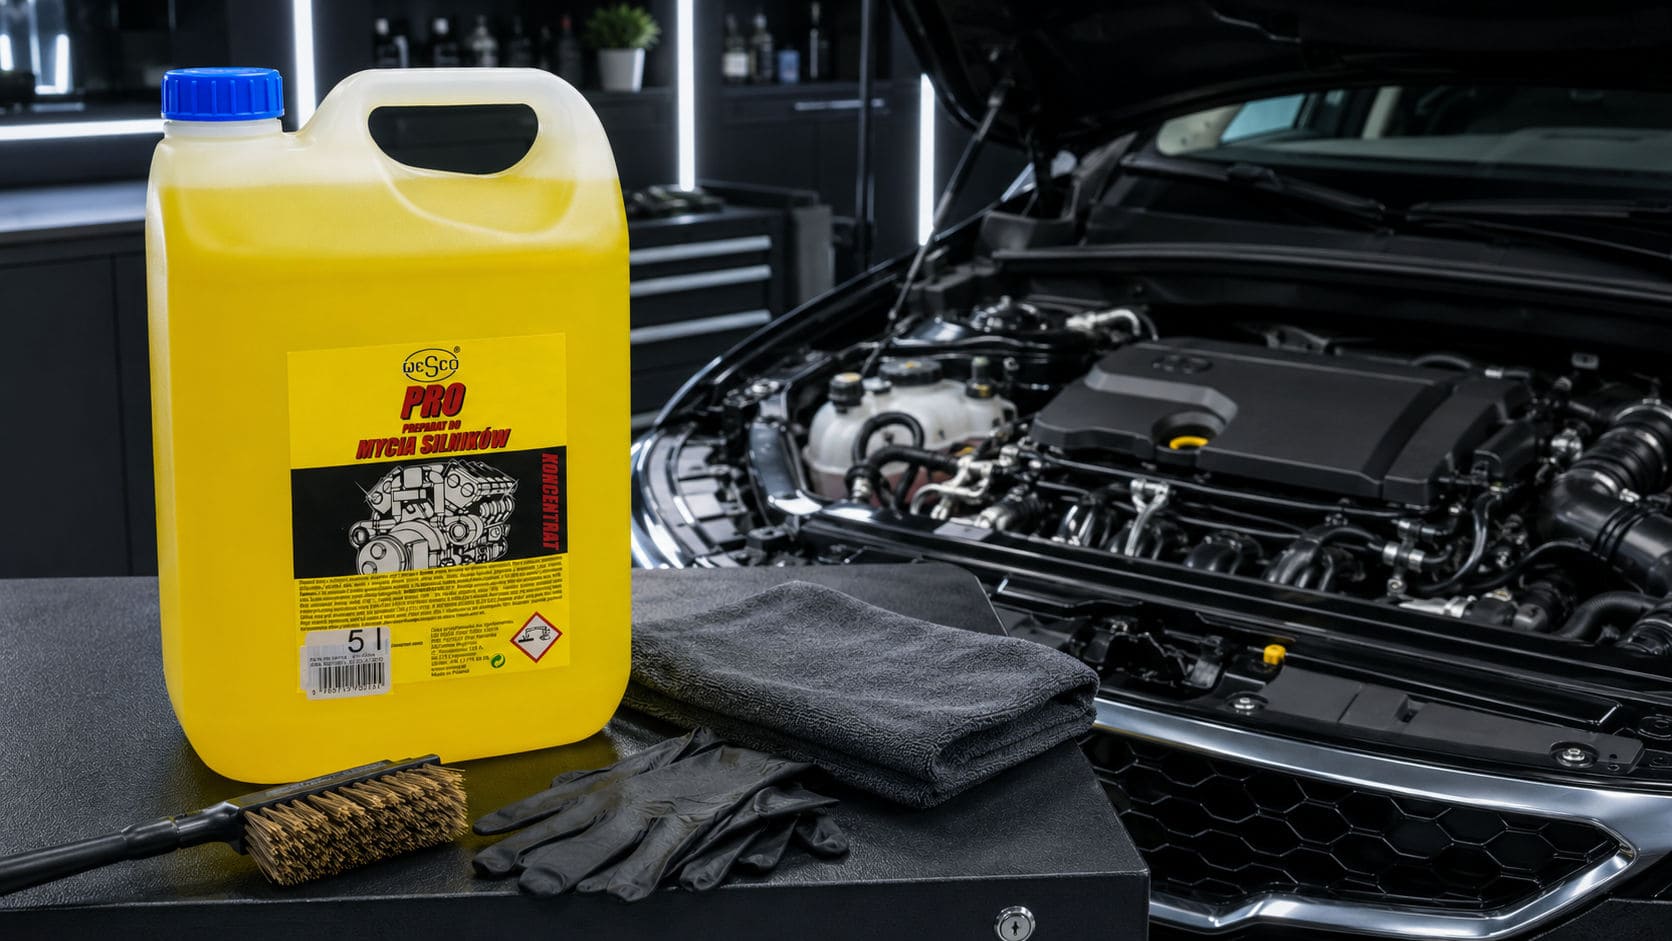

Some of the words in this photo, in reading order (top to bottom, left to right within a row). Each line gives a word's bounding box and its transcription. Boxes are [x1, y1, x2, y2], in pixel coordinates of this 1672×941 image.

[400, 382, 466, 420] PRO
[355, 435, 417, 460] MYCIA
[420, 427, 512, 454] SILNIKÓW
[402, 421, 448, 434] PREPARAT
[448, 420, 461, 430] DO
[542, 453, 559, 551] KONCENTRAT
[348, 629, 364, 653] 5
